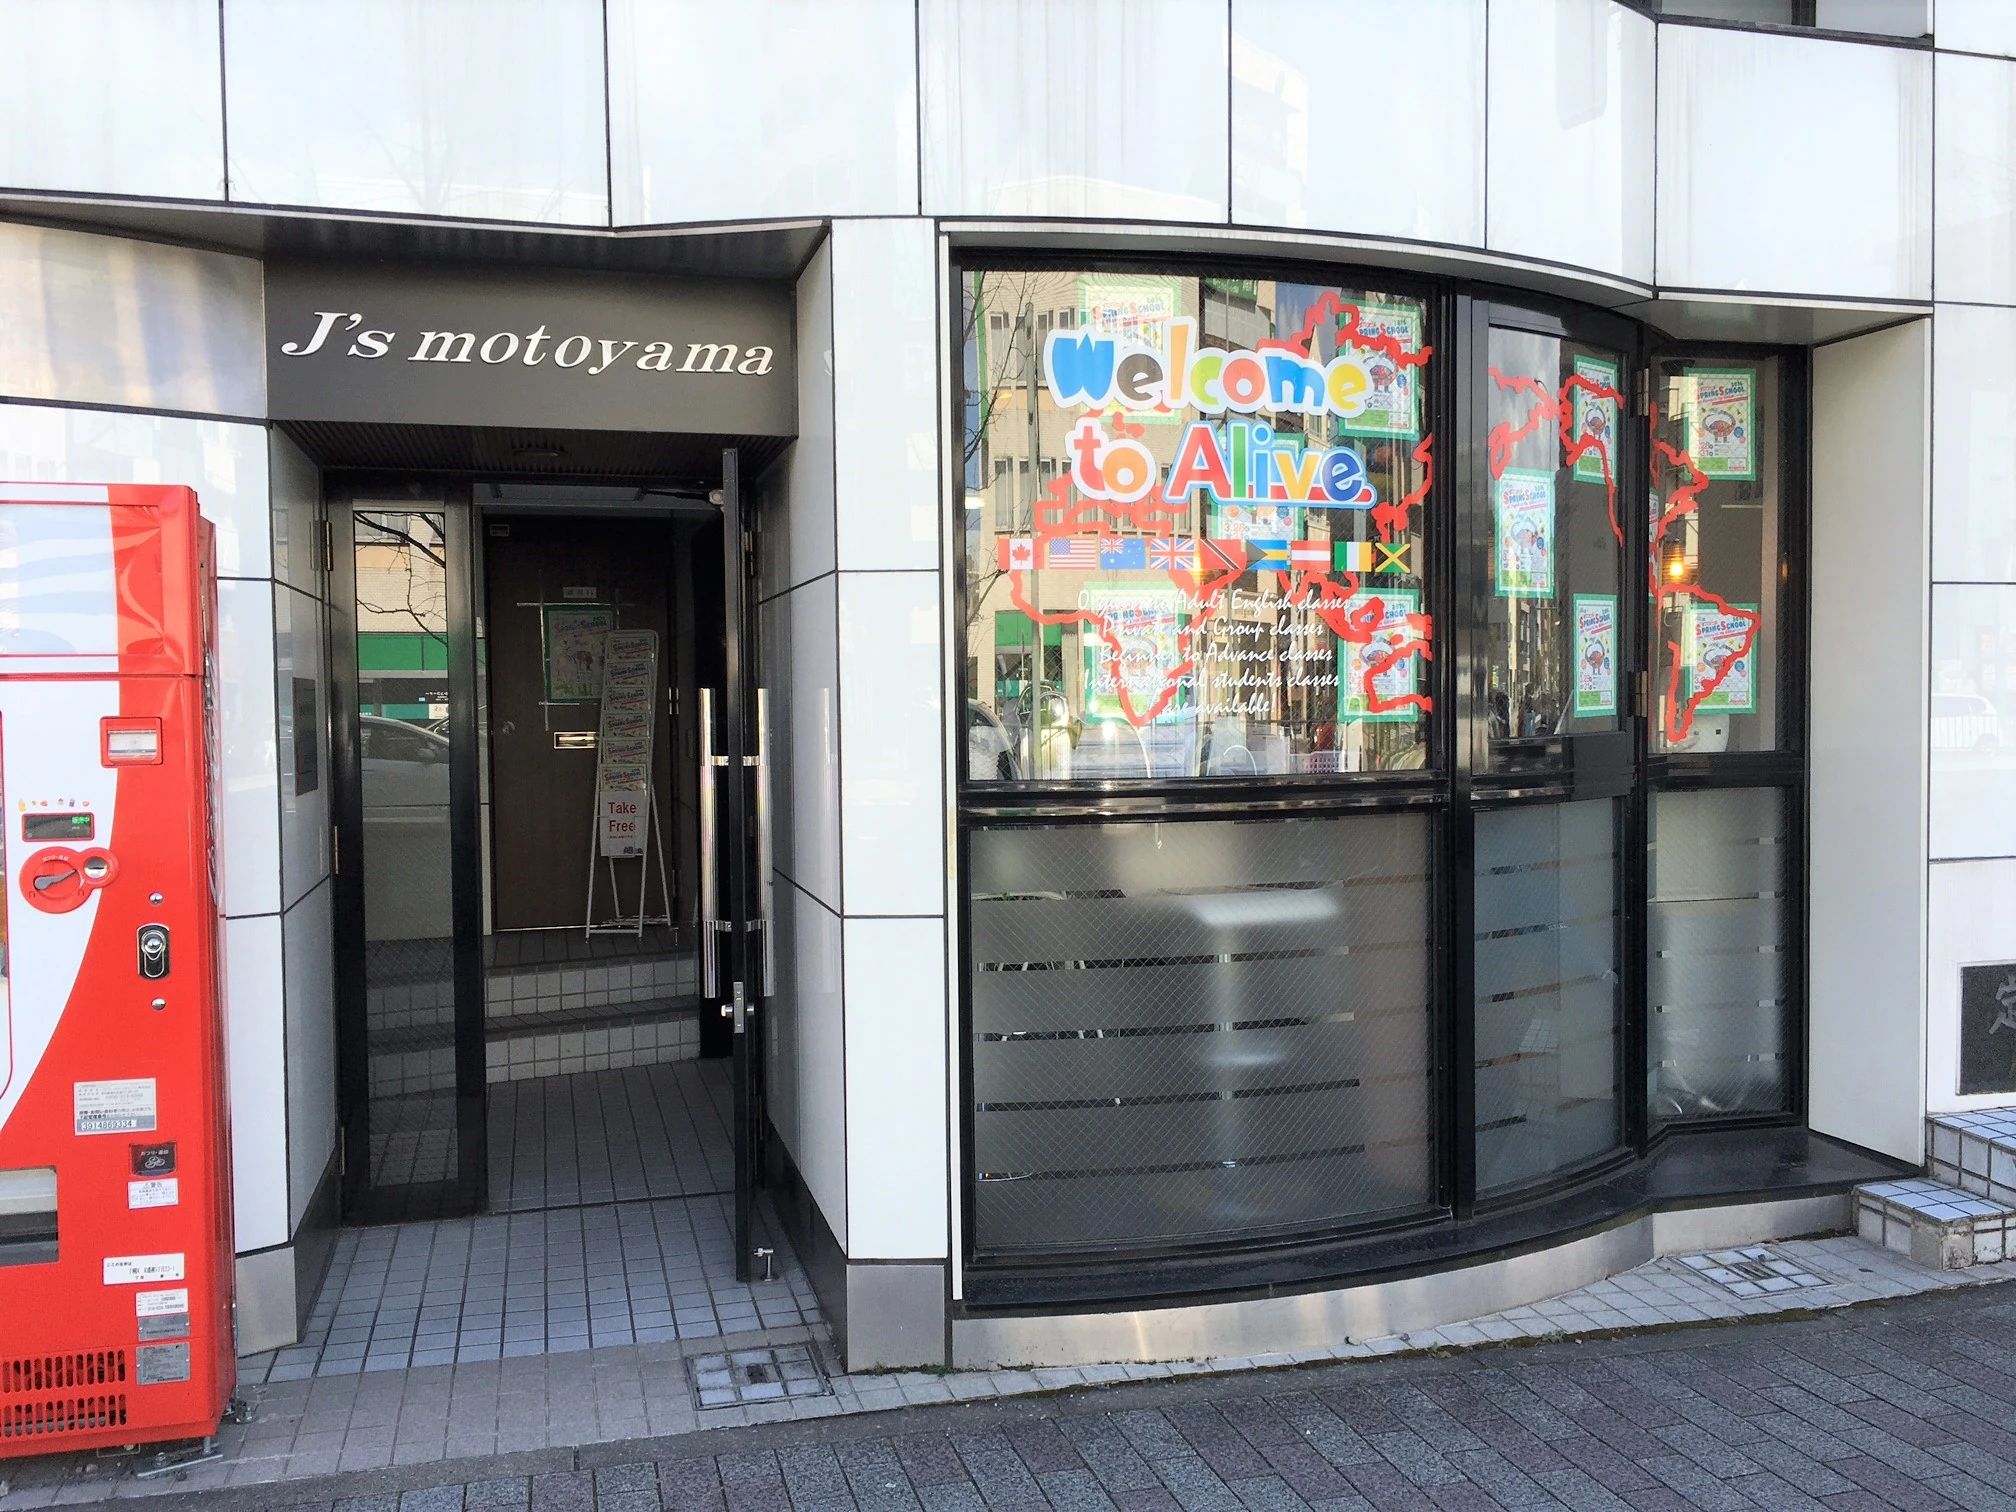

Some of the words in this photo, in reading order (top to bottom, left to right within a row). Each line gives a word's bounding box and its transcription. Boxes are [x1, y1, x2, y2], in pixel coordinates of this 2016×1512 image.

[281, 312, 395, 358] J's
[408, 325, 774, 376] motoyama
[1047, 321, 1371, 414] Welcome
[1071, 422, 1152, 498] to
[1165, 420, 1374, 508] Alive
[1175, 588, 1226, 609] Adult
[1231, 588, 1292, 618] English
[1297, 589, 1350, 610] classes
[1172, 617, 1207, 637] and
[1213, 615, 1264, 643] Group
[1269, 614, 1324, 636] classes
[1182, 644, 1201, 662] to
[1206, 640, 1274, 666] Advance
[1279, 640, 1333, 662] classes
[1211, 667, 1283, 689] students
[1286, 666, 1341, 688] classes
[1194, 692, 1276, 715] available!
[608, 801, 637, 814] Take
[609, 819, 636, 832] Free
